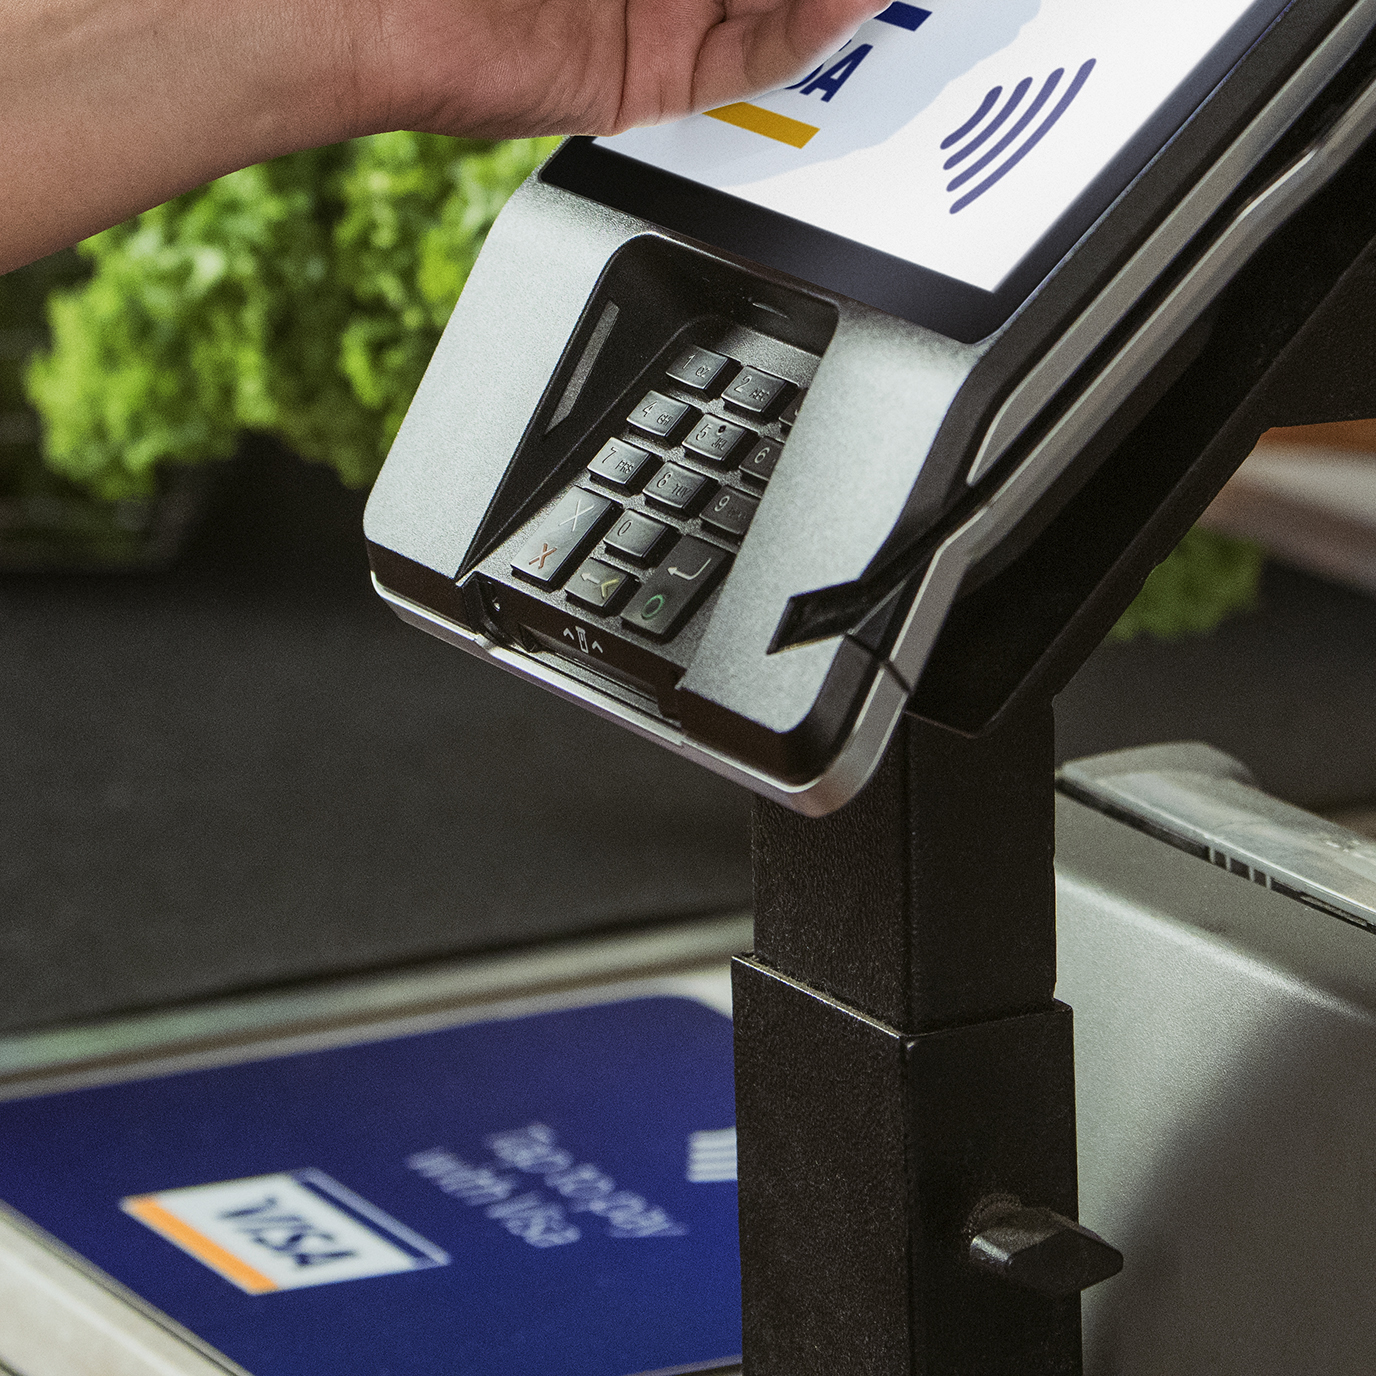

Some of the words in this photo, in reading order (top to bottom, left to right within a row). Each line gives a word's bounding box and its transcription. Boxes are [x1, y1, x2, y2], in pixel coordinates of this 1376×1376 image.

[682, 353, 696, 370] 1
[733, 374, 753, 394] 2
[642, 401, 658, 418] 4
[695, 423, 713, 442] 5
[601, 446, 618, 464] 7
[754, 447, 771, 465] 6
[656, 471, 673, 489] 8
[714, 495, 731, 513] 9
[617, 519, 633, 538] 0
[218, 1198, 358, 1267] VISA
